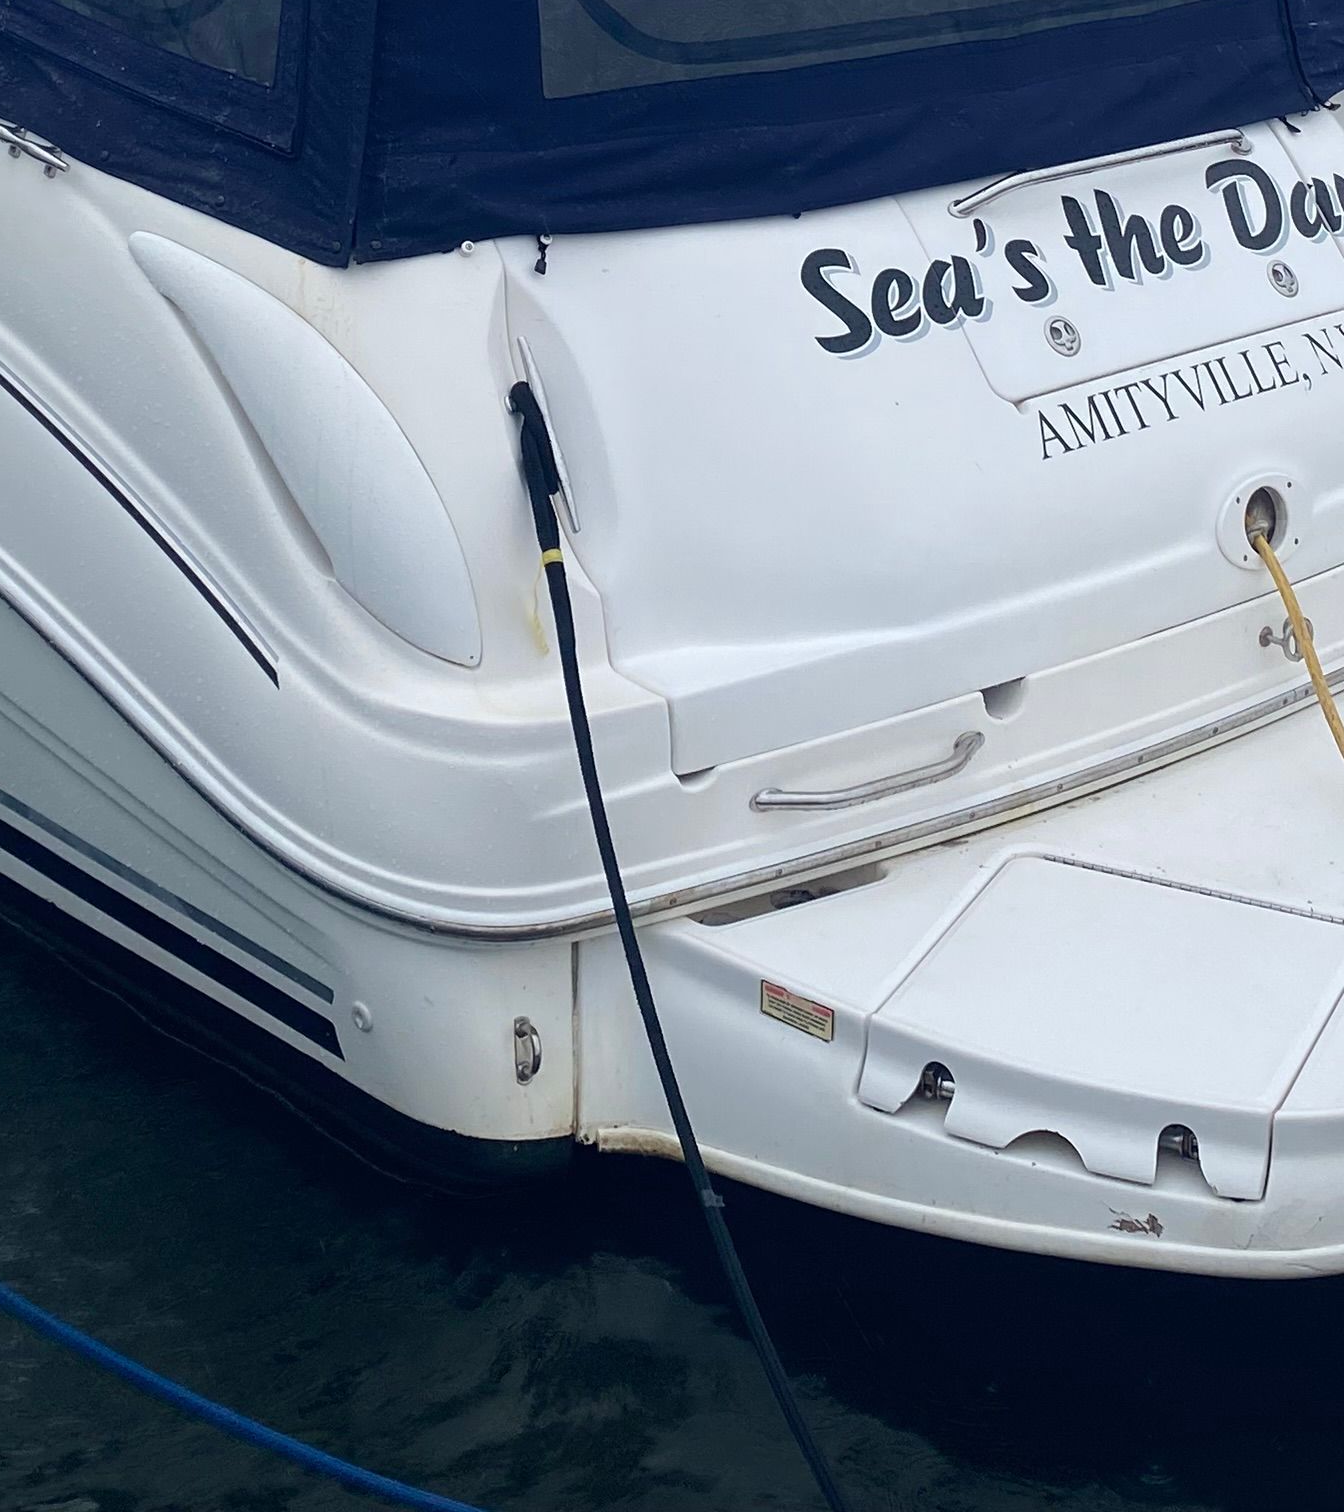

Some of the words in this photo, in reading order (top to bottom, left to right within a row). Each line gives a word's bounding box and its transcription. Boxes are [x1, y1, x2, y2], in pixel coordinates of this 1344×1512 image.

[800, 218, 1053, 356] Sea's
[1062, 188, 1205, 289] the
[1036, 341, 1313, 461] AMITYVILLE,
